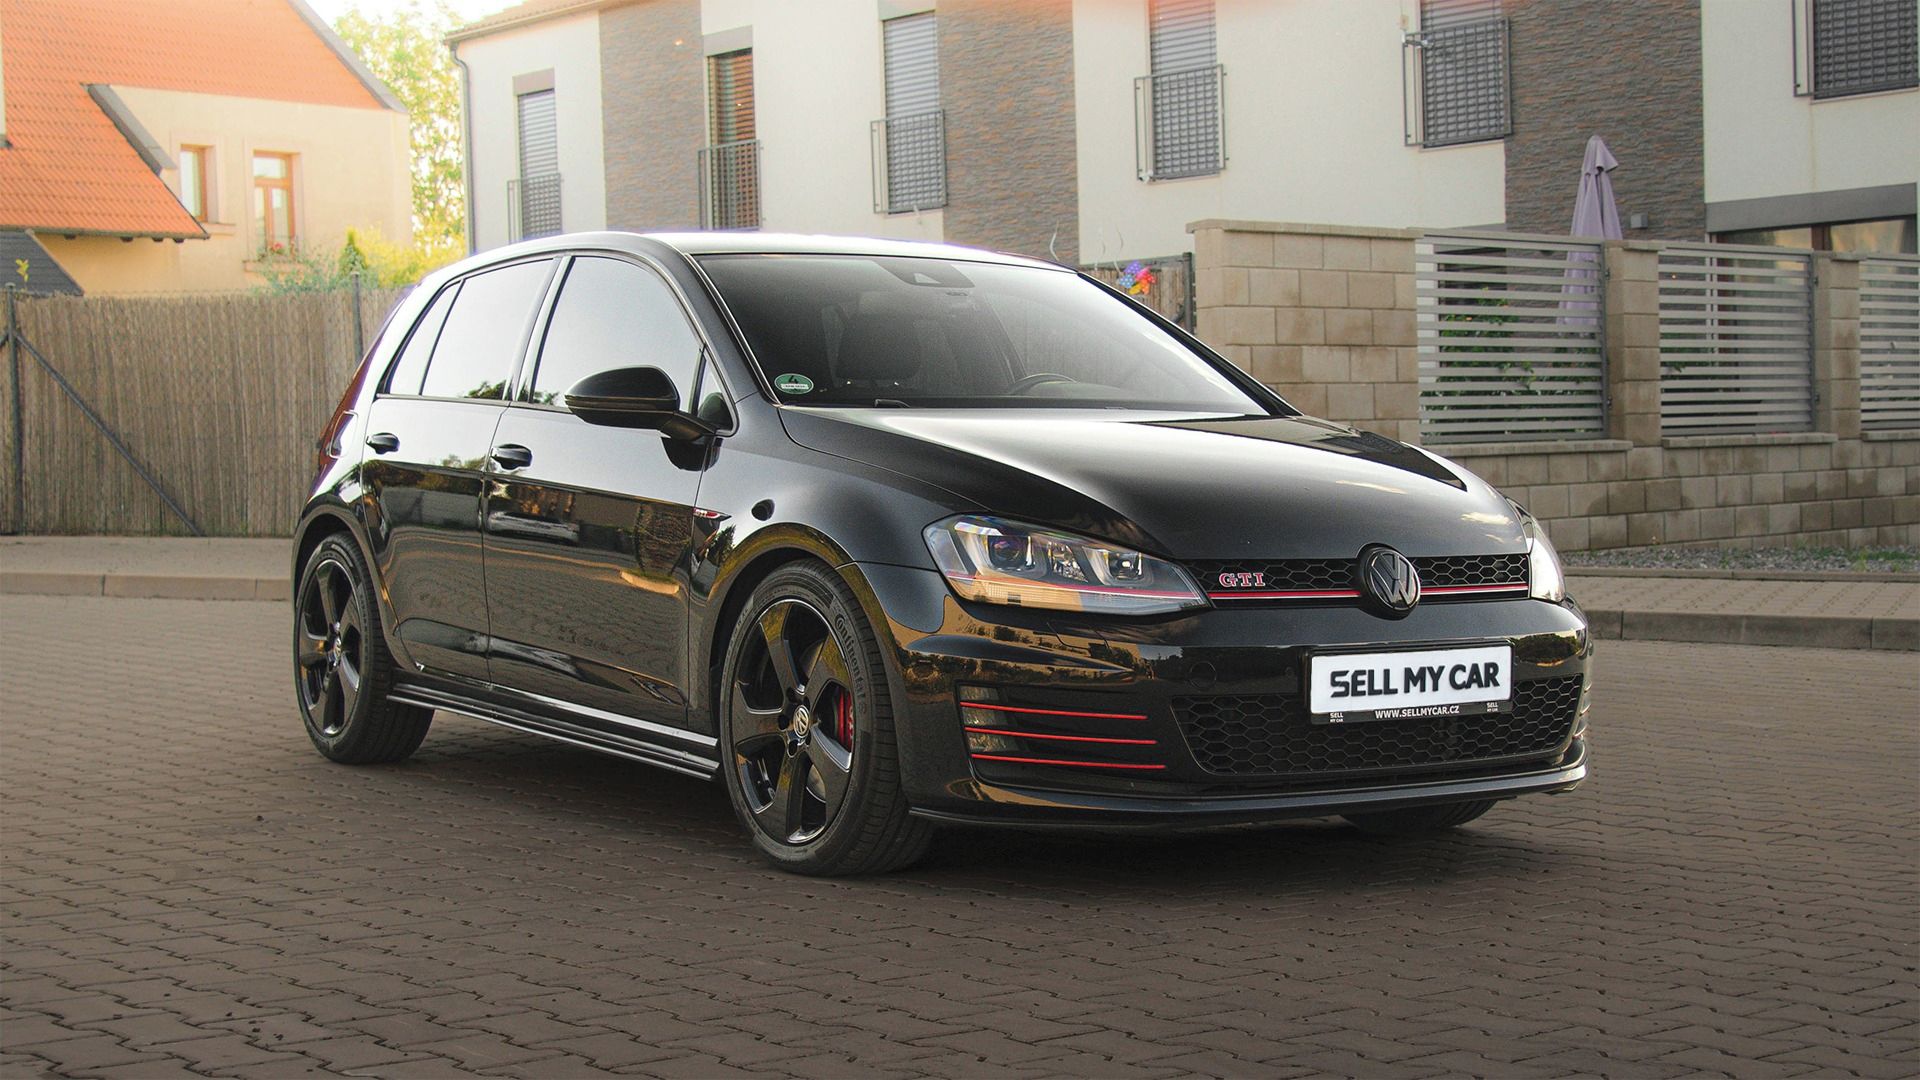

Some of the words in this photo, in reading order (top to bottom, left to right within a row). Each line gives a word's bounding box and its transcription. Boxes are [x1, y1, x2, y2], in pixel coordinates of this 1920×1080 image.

[1218, 572, 1266, 588] GTI
[834, 613, 866, 698] Continental
[1330, 668, 1398, 698] SELL
[1403, 665, 1446, 694] MY
[1448, 661, 1500, 691] CAR
[1375, 705, 1460, 719] WWW.SELLMYCAR.CZ
